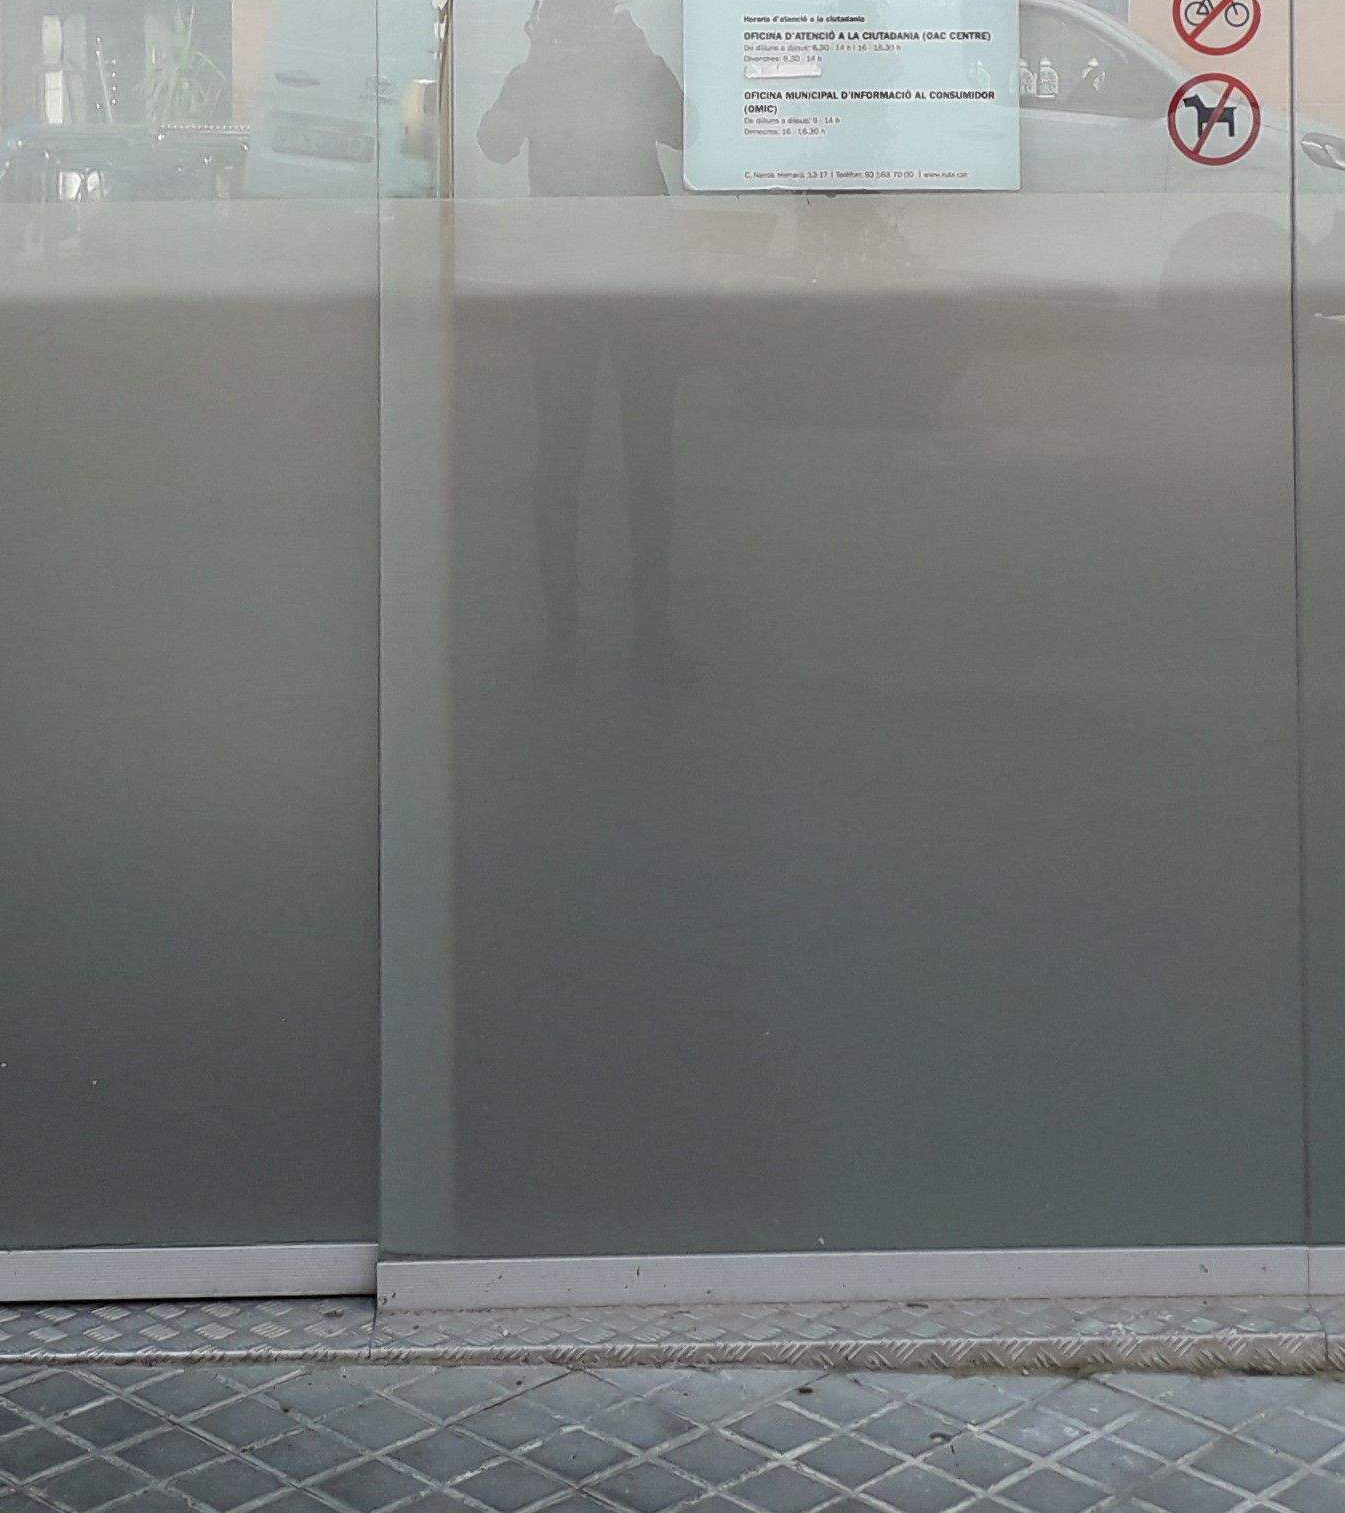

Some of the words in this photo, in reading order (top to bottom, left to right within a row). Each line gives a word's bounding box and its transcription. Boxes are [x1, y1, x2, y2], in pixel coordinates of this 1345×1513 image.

[744, 32, 782, 40] OFICINA
[837, 32, 845, 40] A
[847, 32, 859, 40] LA
[862, 32, 919, 40] CIUTADANIA
[922, 31, 946, 41] (OAC
[949, 31, 991, 41] CENTRE)
[744, 91, 782, 99] OFICINA
[785, 91, 838, 99] MUNICIPAL
[914, 91, 926, 99] AL
[929, 91, 995, 99] CONSUMIDOR
[743, 105, 778, 114] (OMIC)
